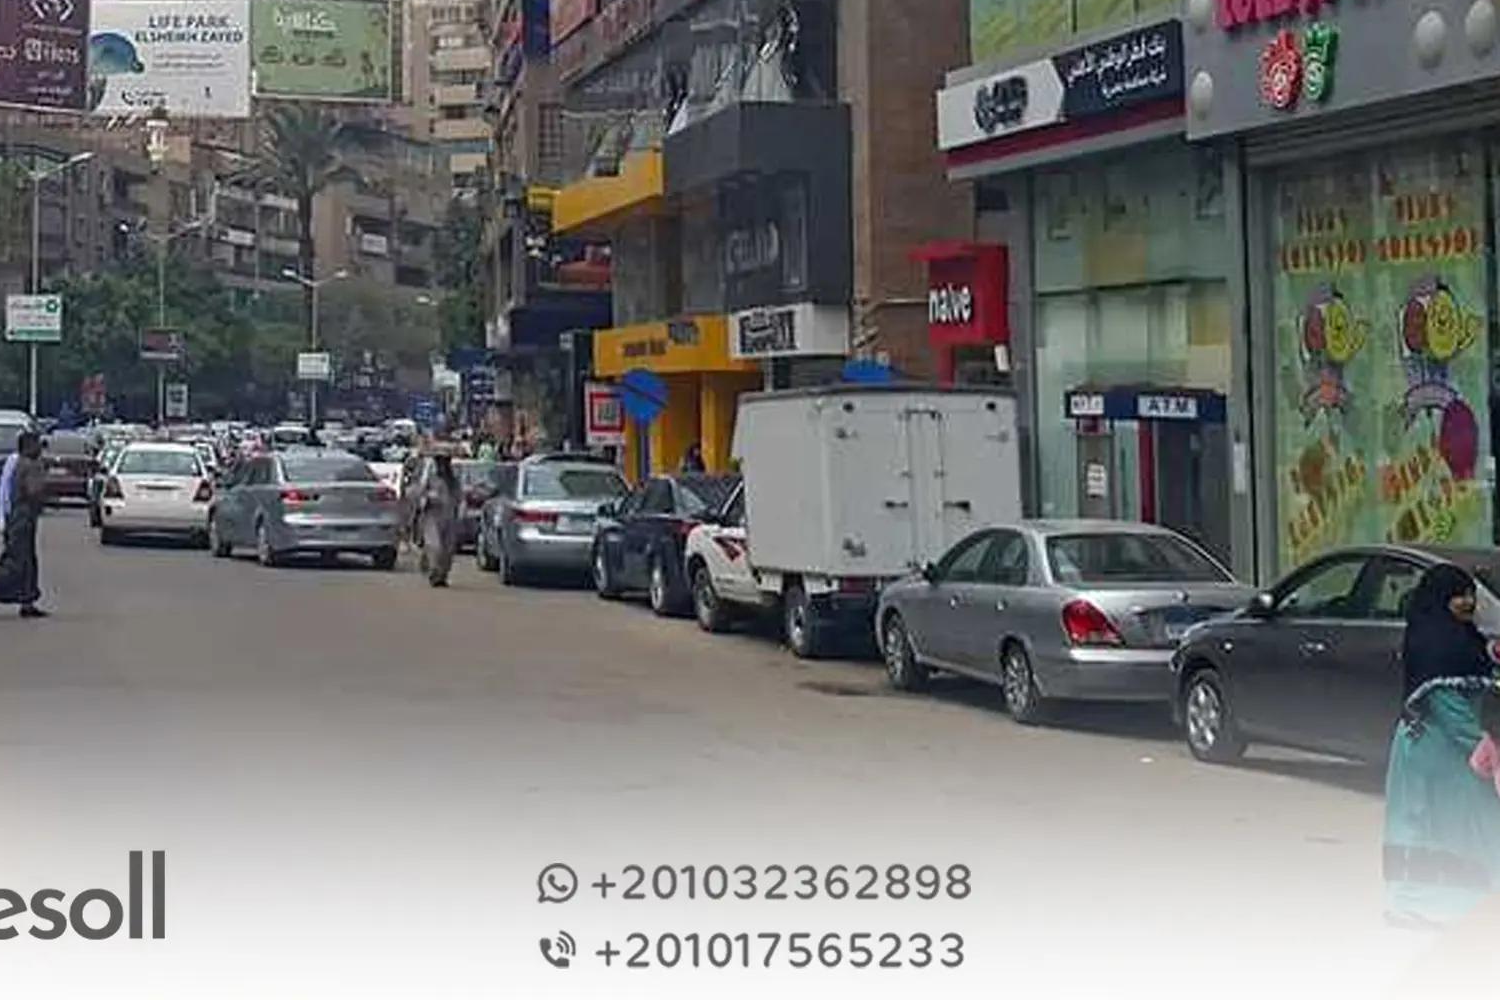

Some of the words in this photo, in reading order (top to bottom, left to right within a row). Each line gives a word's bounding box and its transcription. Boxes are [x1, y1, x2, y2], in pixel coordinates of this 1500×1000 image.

[148, 15, 182, 28] LIFE
[187, 15, 229, 28] PARK
[200, 30, 244, 43] ZAYED
